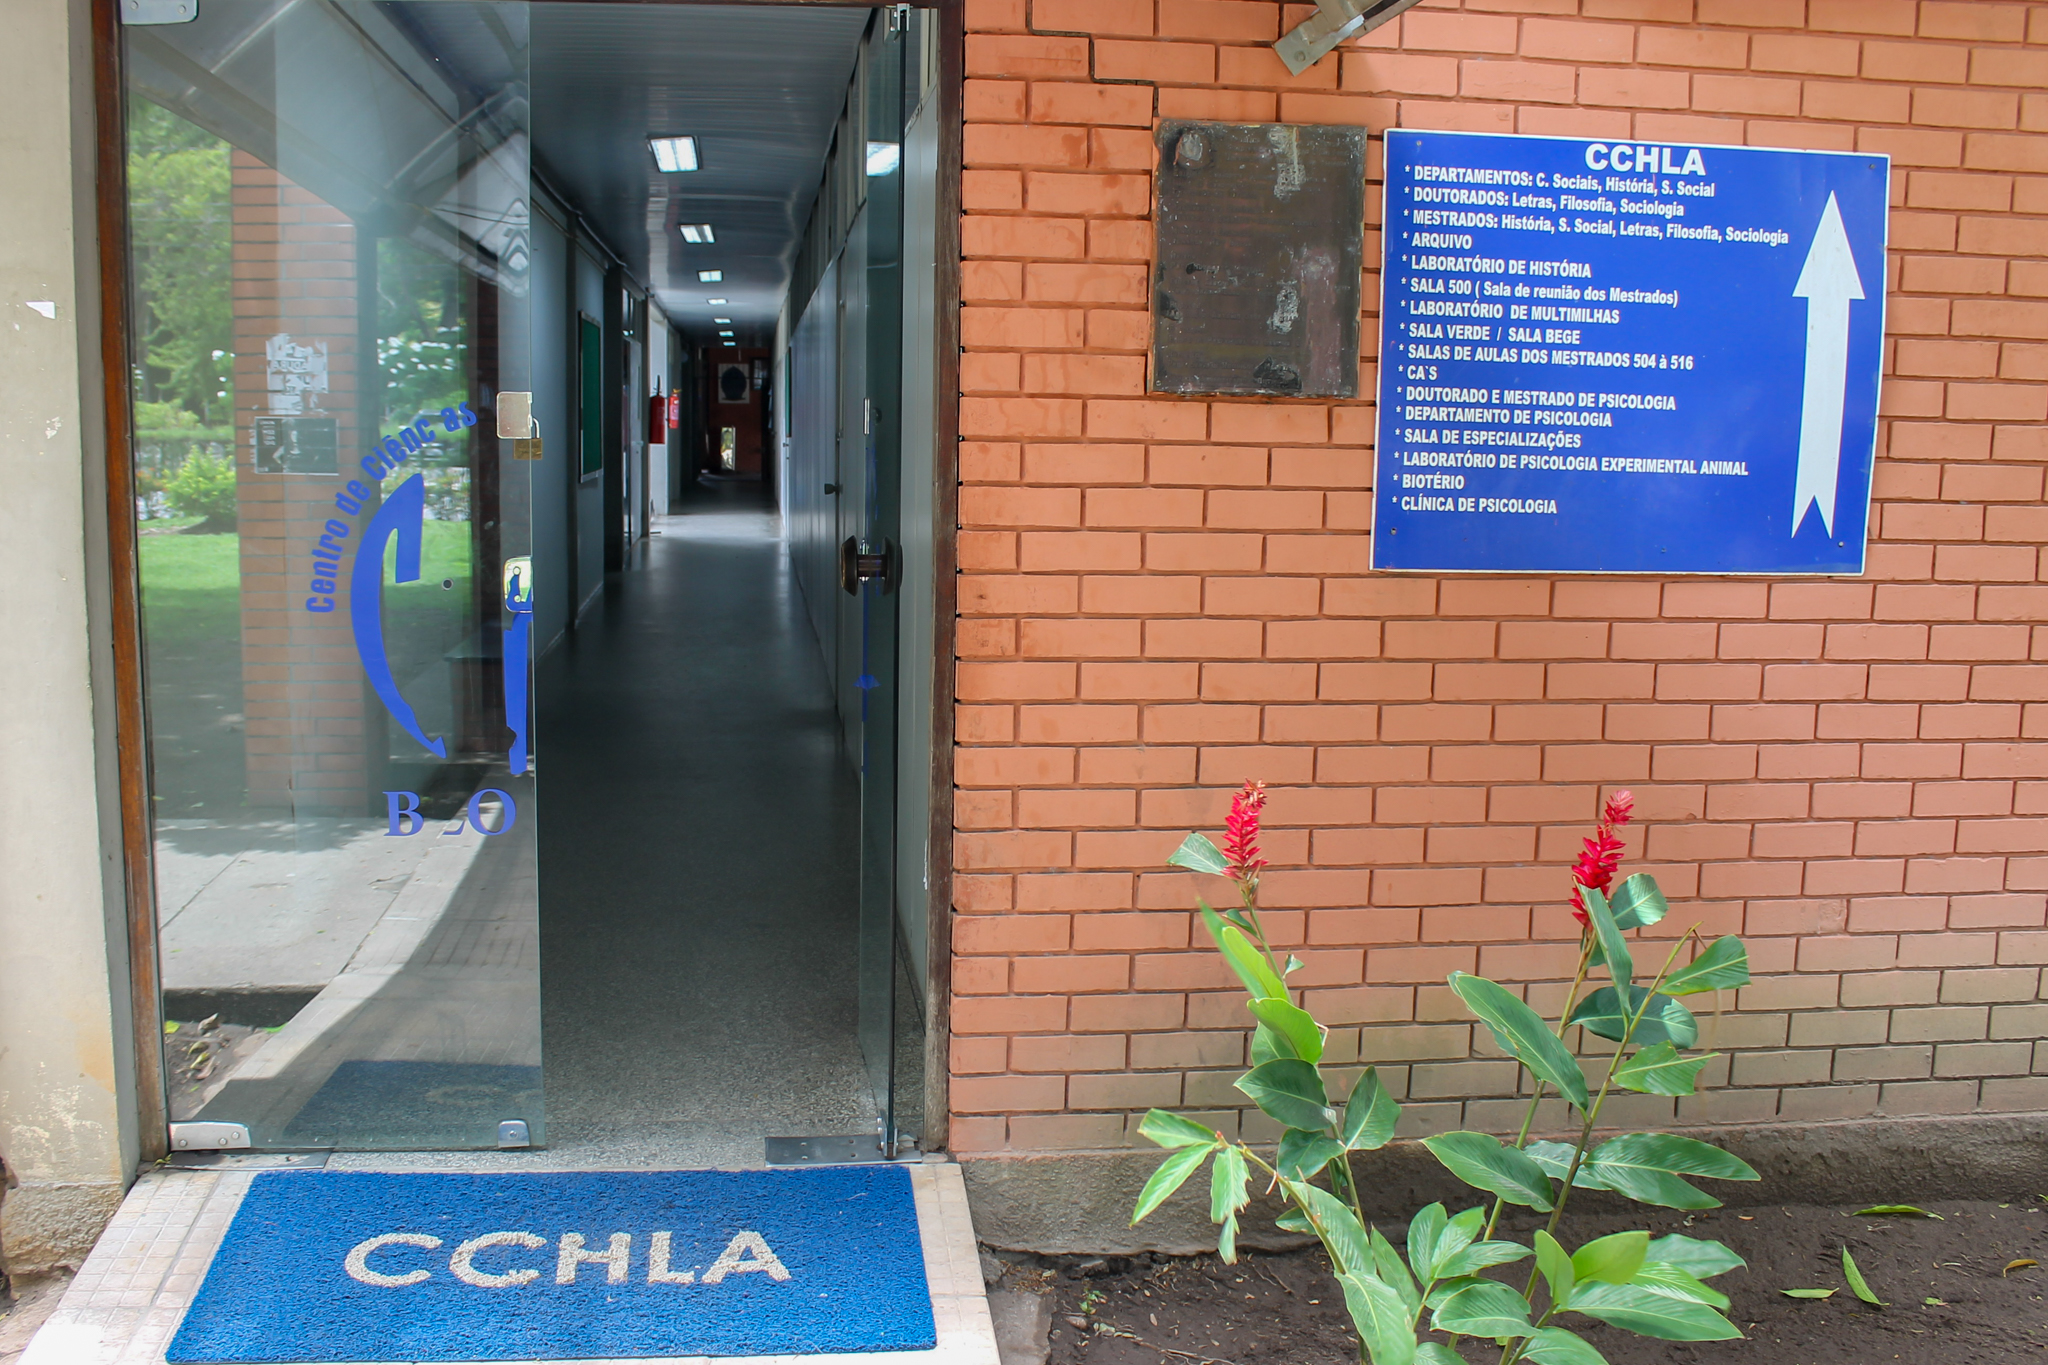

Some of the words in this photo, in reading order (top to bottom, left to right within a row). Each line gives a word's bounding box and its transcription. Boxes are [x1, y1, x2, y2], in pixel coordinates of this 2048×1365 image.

[1586, 143, 1706, 175] CCHLA
[1415, 165, 1533, 186] DEPARTAMENTOS:
[1536, 172, 1549, 187] C.
[1553, 173, 1602, 193] Sociais,
[1606, 174, 1658, 196] História,
[1662, 180, 1673, 194] S.
[1677, 181, 1715, 197] Social
[1414, 187, 1509, 206] DOUTORADOS:
[1513, 192, 1556, 211] Letras,
[1560, 195, 1616, 215] Filosofia,
[1620, 198, 1684, 219] Sociologia
[1414, 210, 1498, 228] MESTRADOS:
[1502, 214, 1555, 234] História,
[1559, 217, 1571, 232] S.
[1574, 218, 1616, 237] Social,
[1620, 221, 1663, 240] Letras,
[1667, 223, 1722, 243] Filosofia,
[1726, 227, 1789, 246] Sociologia
[1412, 232, 1472, 249] ARQUIVO
[1412, 255, 1505, 273] LABORATÓRIO
[1509, 260, 1526, 274] DE
[1530, 259, 1591, 278] HISTÓRIA
[1411, 278, 1445, 293] SALA
[1449, 280, 1472, 294] 500
[1484, 281, 1511, 296] Sala
[1515, 283, 1530, 297] de
[1534, 285, 1581, 300] reunião
[1584, 286, 1606, 301] dos
[1610, 287, 1678, 308] Mestrados)
[1411, 300, 1503, 318] LABORATÓRIO
[1511, 305, 1528, 319] DE
[1532, 306, 1620, 323] MULTIMILHAS
[1409, 323, 1443, 338] SALA
[1447, 325, 1490, 340] VERDE
[1497, 327, 1501, 340] /
[1508, 327, 1542, 342] SALA
[1546, 329, 1581, 344] BEGE
[1408, 344, 1450, 359] SALAS
[1455, 346, 1471, 360] DE
[1475, 347, 1518, 362] AULAS
[1522, 349, 1548, 363] DOS
[1552, 350, 1630, 367] MESTRADOS
[1634, 354, 1656, 368] 504
[1659, 354, 1667, 368] à
[1671, 355, 1694, 370] 516
[1407, 386, 1488, 403] DOUTORADO
[1492, 390, 1500, 403] E
[1504, 390, 1575, 406] MESTRADO
[1579, 393, 1595, 407] DE
[1599, 393, 1676, 410] PSICOLOGIA
[1406, 406, 1510, 423] DEPARTAMENTO
[1514, 410, 1531, 424] DE
[1535, 410, 1612, 427] PSICOLOGIA
[1405, 428, 1438, 443] SALA
[1443, 430, 1459, 444] DE
[1464, 430, 1581, 451] ESPECIALIZAÇÕES
[335, 479, 371, 516] de
[360, 401, 477, 481] Ciêncas
[1404, 450, 1496, 468] LABORATÓRIO
[1500, 454, 1517, 468] DE
[1521, 455, 1598, 471] PSICOLOGIA
[1602, 457, 1697, 474] EXPERIMENTAL
[1700, 461, 1749, 475] ANIMAL
[1403, 471, 1464, 489] BIOTÉRIO
[1402, 493, 1454, 511] CLÍNICA
[1459, 498, 1475, 511] DE
[1479, 498, 1557, 513] PSICOLOGIA
[344, 1230, 792, 1287] CCHLA
